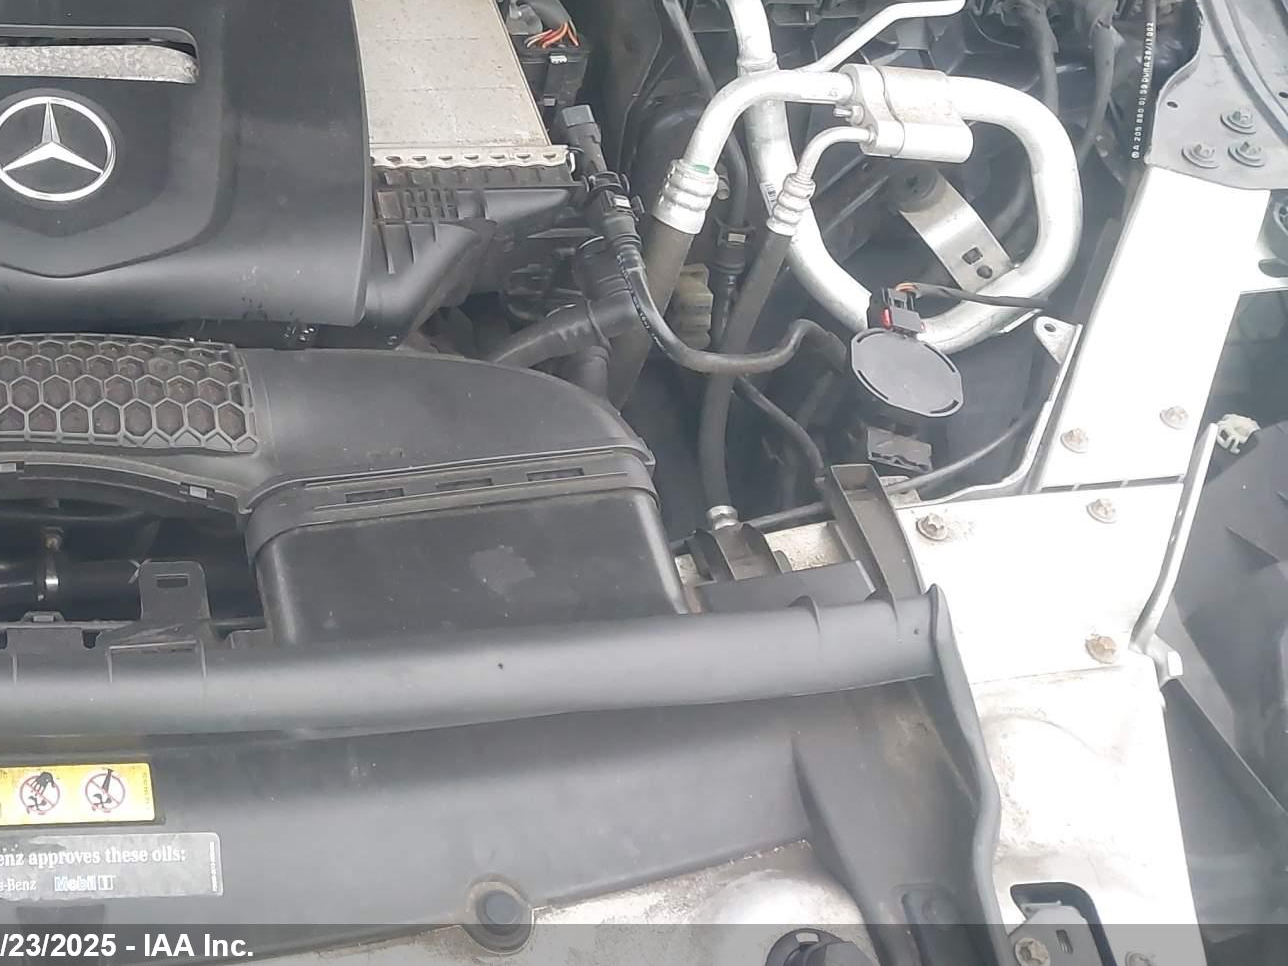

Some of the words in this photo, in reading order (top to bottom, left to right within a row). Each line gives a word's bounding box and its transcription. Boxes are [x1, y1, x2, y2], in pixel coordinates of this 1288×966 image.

[28, 849, 101, 869] approves
[105, 846, 148, 864] these
[152, 845, 187, 863] oils:
